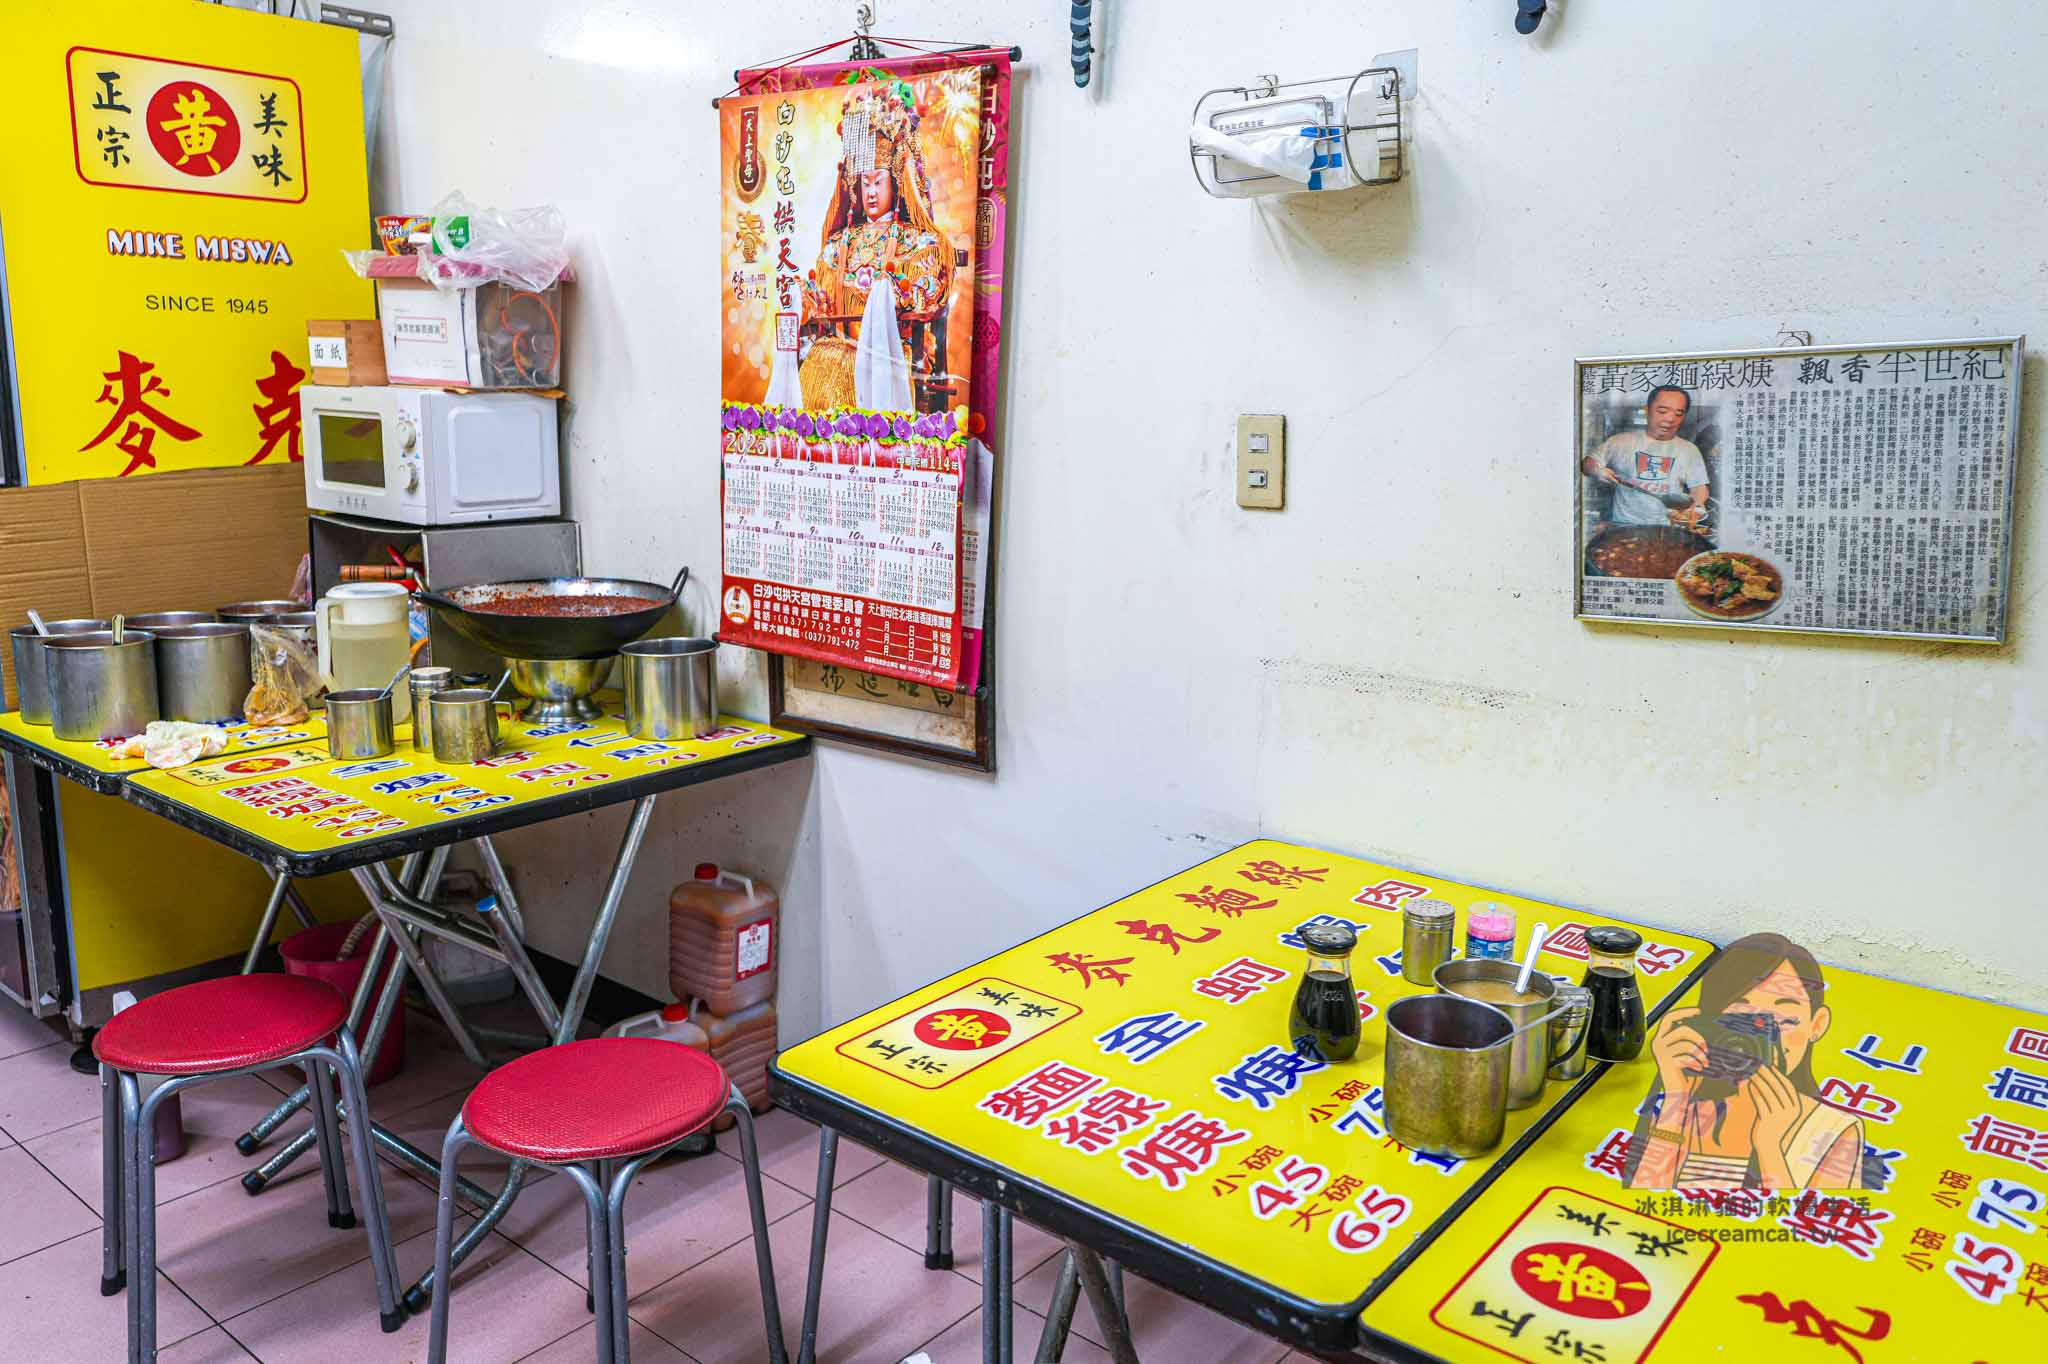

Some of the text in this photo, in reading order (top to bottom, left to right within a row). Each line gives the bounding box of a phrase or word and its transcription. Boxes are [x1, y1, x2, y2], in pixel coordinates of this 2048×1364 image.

[93, 71, 132, 168] 正宗
[160, 89, 227, 174] 黃
[253, 92, 292, 187] 美味
[107, 228, 293, 267] MIKE MISWA
[146, 295, 268, 314] SINCE 1945
[314, 343, 342, 361] 面紙
[1797, 347, 2006, 385] 飄香半世紀
[726, 433, 767, 454] 2025
[416, 786, 482, 804] 75
[552, 773, 611, 787] 70
[314, 809, 379, 828] 45
[438, 795, 513, 815] 120
[339, 818, 407, 838] 65
[1043, 861, 1329, 989] 麥克麵線
[1636, 944, 1685, 975] 45
[976, 985, 1060, 1022] 美味
[928, 1013, 1010, 1048] 黃
[866, 1038, 948, 1076] 正宗
[1309, 1080, 1371, 1123] 小碗
[985, 1065, 1246, 1188] 麵線焿
[1211, 1145, 1284, 1197] 小碗
[1255, 1158, 1323, 1216] 45
[1931, 1169, 1972, 1209] 小碗
[1289, 1174, 1364, 1233] 大碗
[1336, 1189, 1406, 1250] 65
[1976, 1179, 2038, 1229] 75
[1556, 1205, 1688, 1257] 美味
[1902, 1227, 1947, 1272] 小碗
[1526, 1253, 1650, 1315] 黃
[1954, 1236, 2014, 1299] 45
